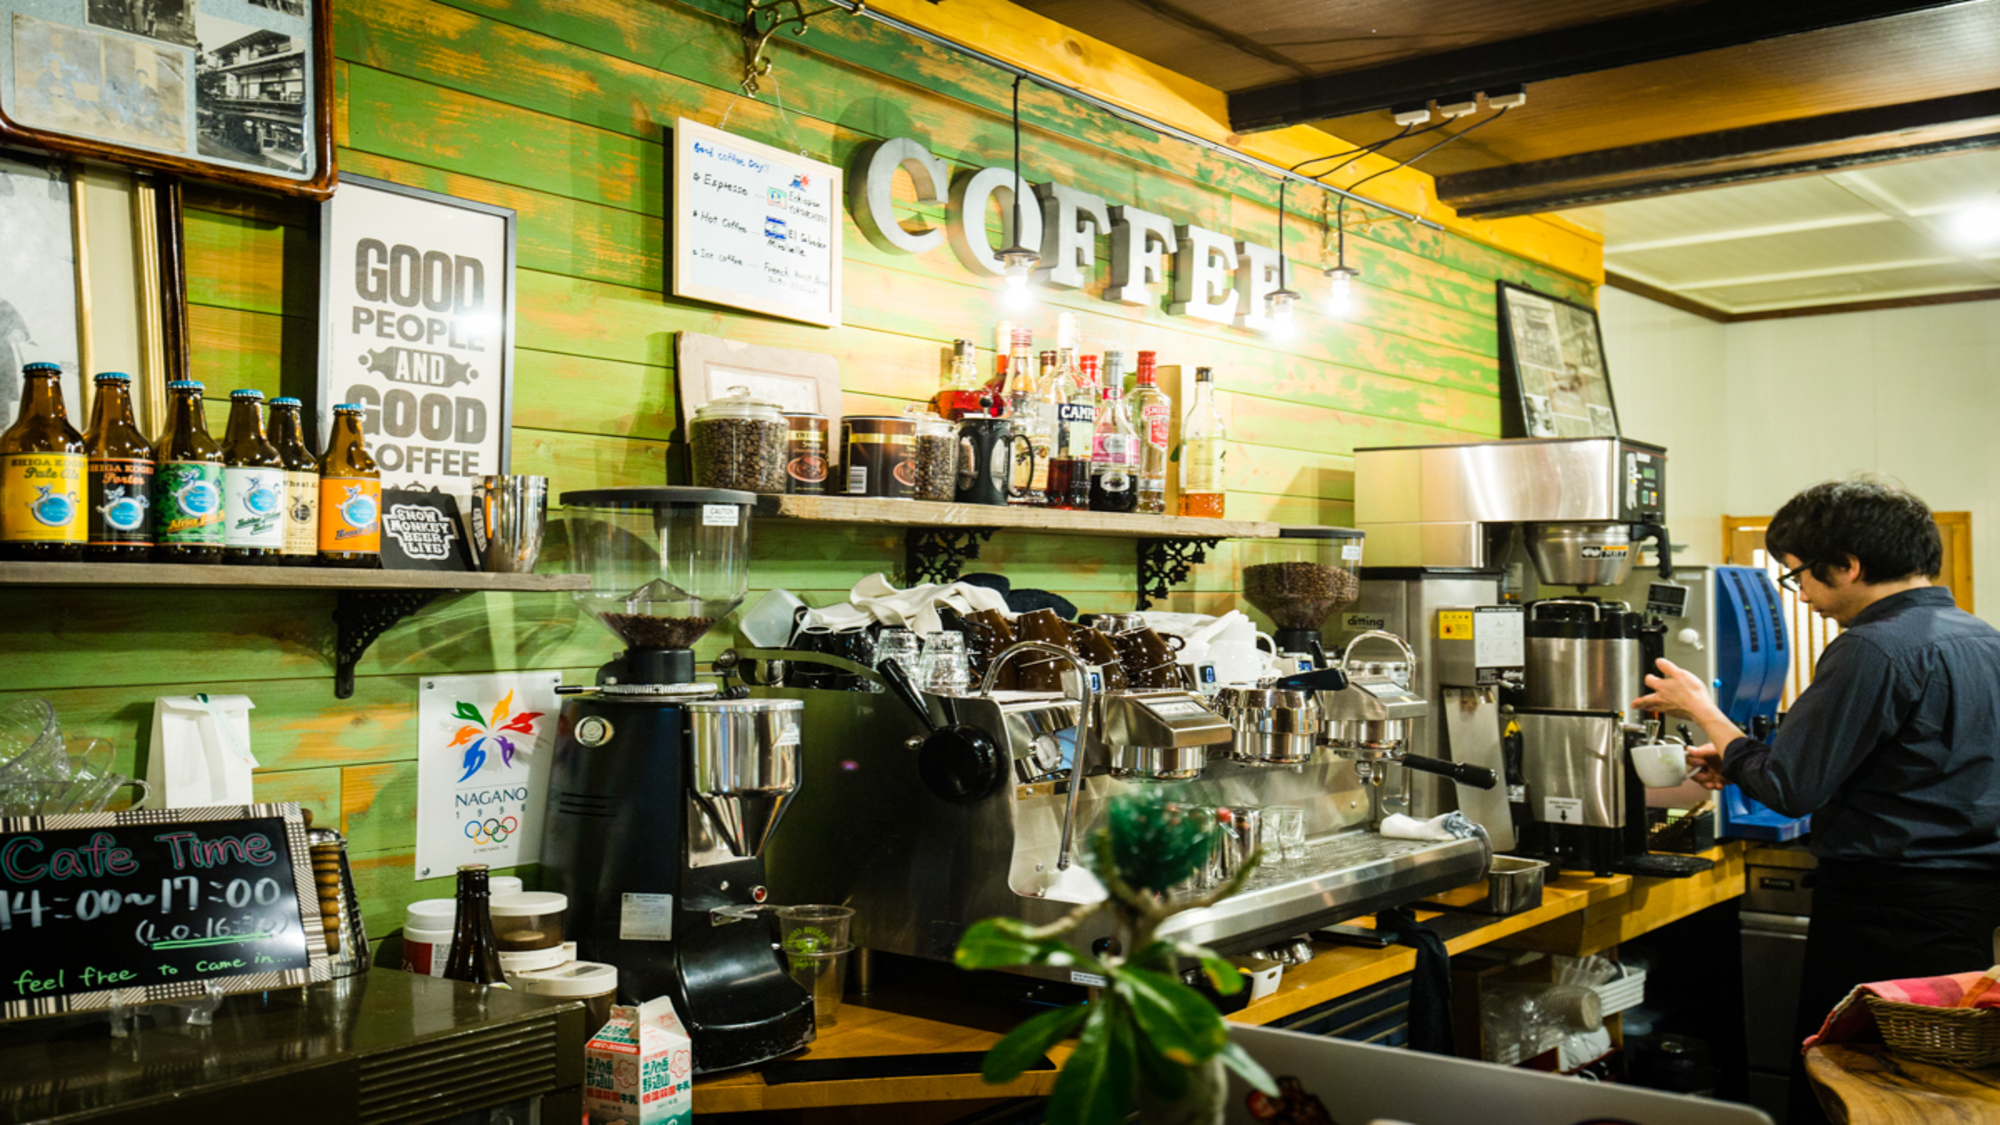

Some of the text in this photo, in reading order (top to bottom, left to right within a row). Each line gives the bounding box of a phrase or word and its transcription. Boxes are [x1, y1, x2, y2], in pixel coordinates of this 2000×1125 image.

[703, 173, 749, 196] Espresso
[850, 137, 1290, 334] COFFEE
[354, 236, 485, 316] GOOD
[351, 305, 486, 353] PEOPLE
[394, 350, 446, 386] AND
[344, 383, 488, 444] GOOD
[363, 441, 480, 477] OFFEE
[102, 472, 145, 486] Porter
[391, 520, 450, 534] MONKEY
[397, 509, 437, 522] SNOW
[403, 532, 443, 543] BEER
[407, 543, 444, 555] LIVE
[455, 786, 528, 807] NAGANO
[1, 831, 277, 884] Cafe Time
[13, 968, 65, 995] feel
[79, 966, 138, 987] free
[158, 964, 178, 976] to
